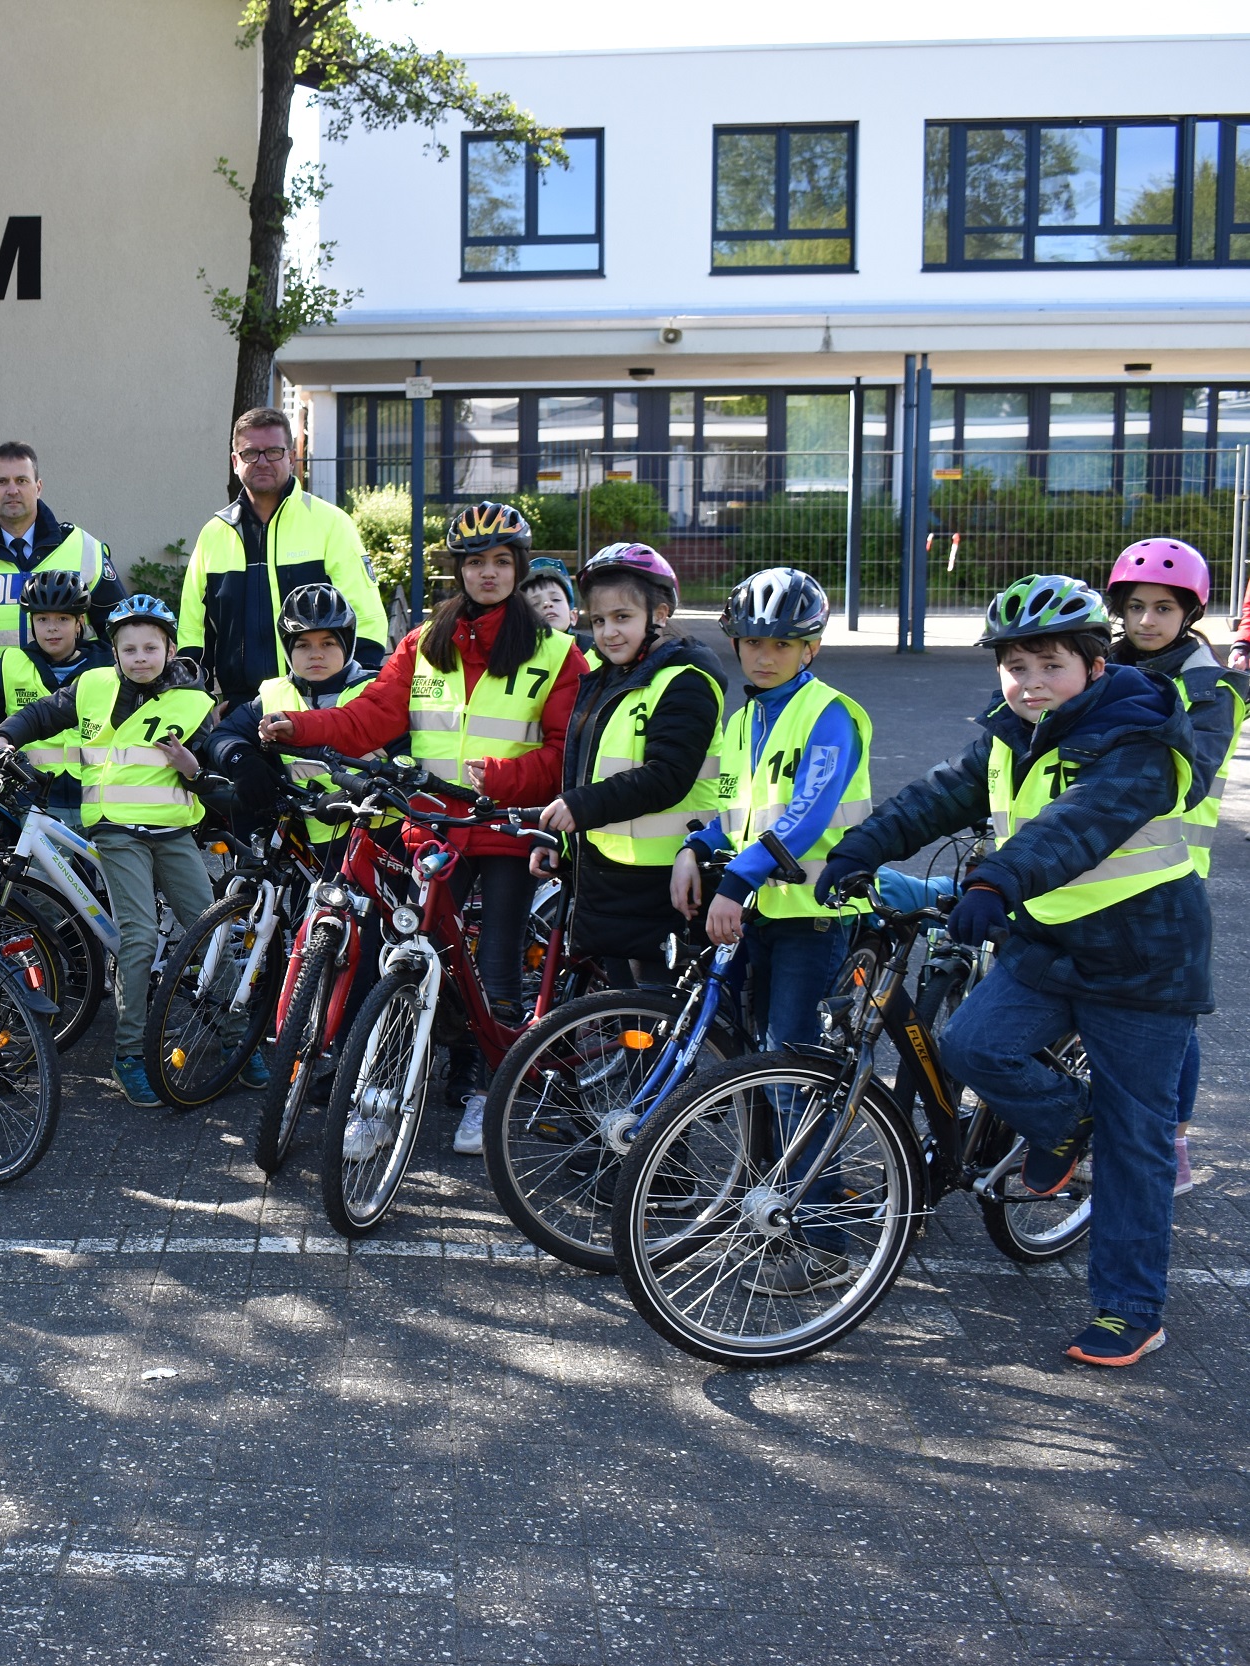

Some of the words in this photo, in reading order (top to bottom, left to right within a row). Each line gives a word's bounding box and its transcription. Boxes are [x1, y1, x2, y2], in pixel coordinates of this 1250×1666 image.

[411, 686, 433, 695] WACHT
[412, 678, 445, 688] VERKEHRS
[504, 667, 550, 700] 17
[142, 715, 185, 746] 12
[767, 747, 802, 785] 14
[908, 1029, 930, 1063] FLYKE
